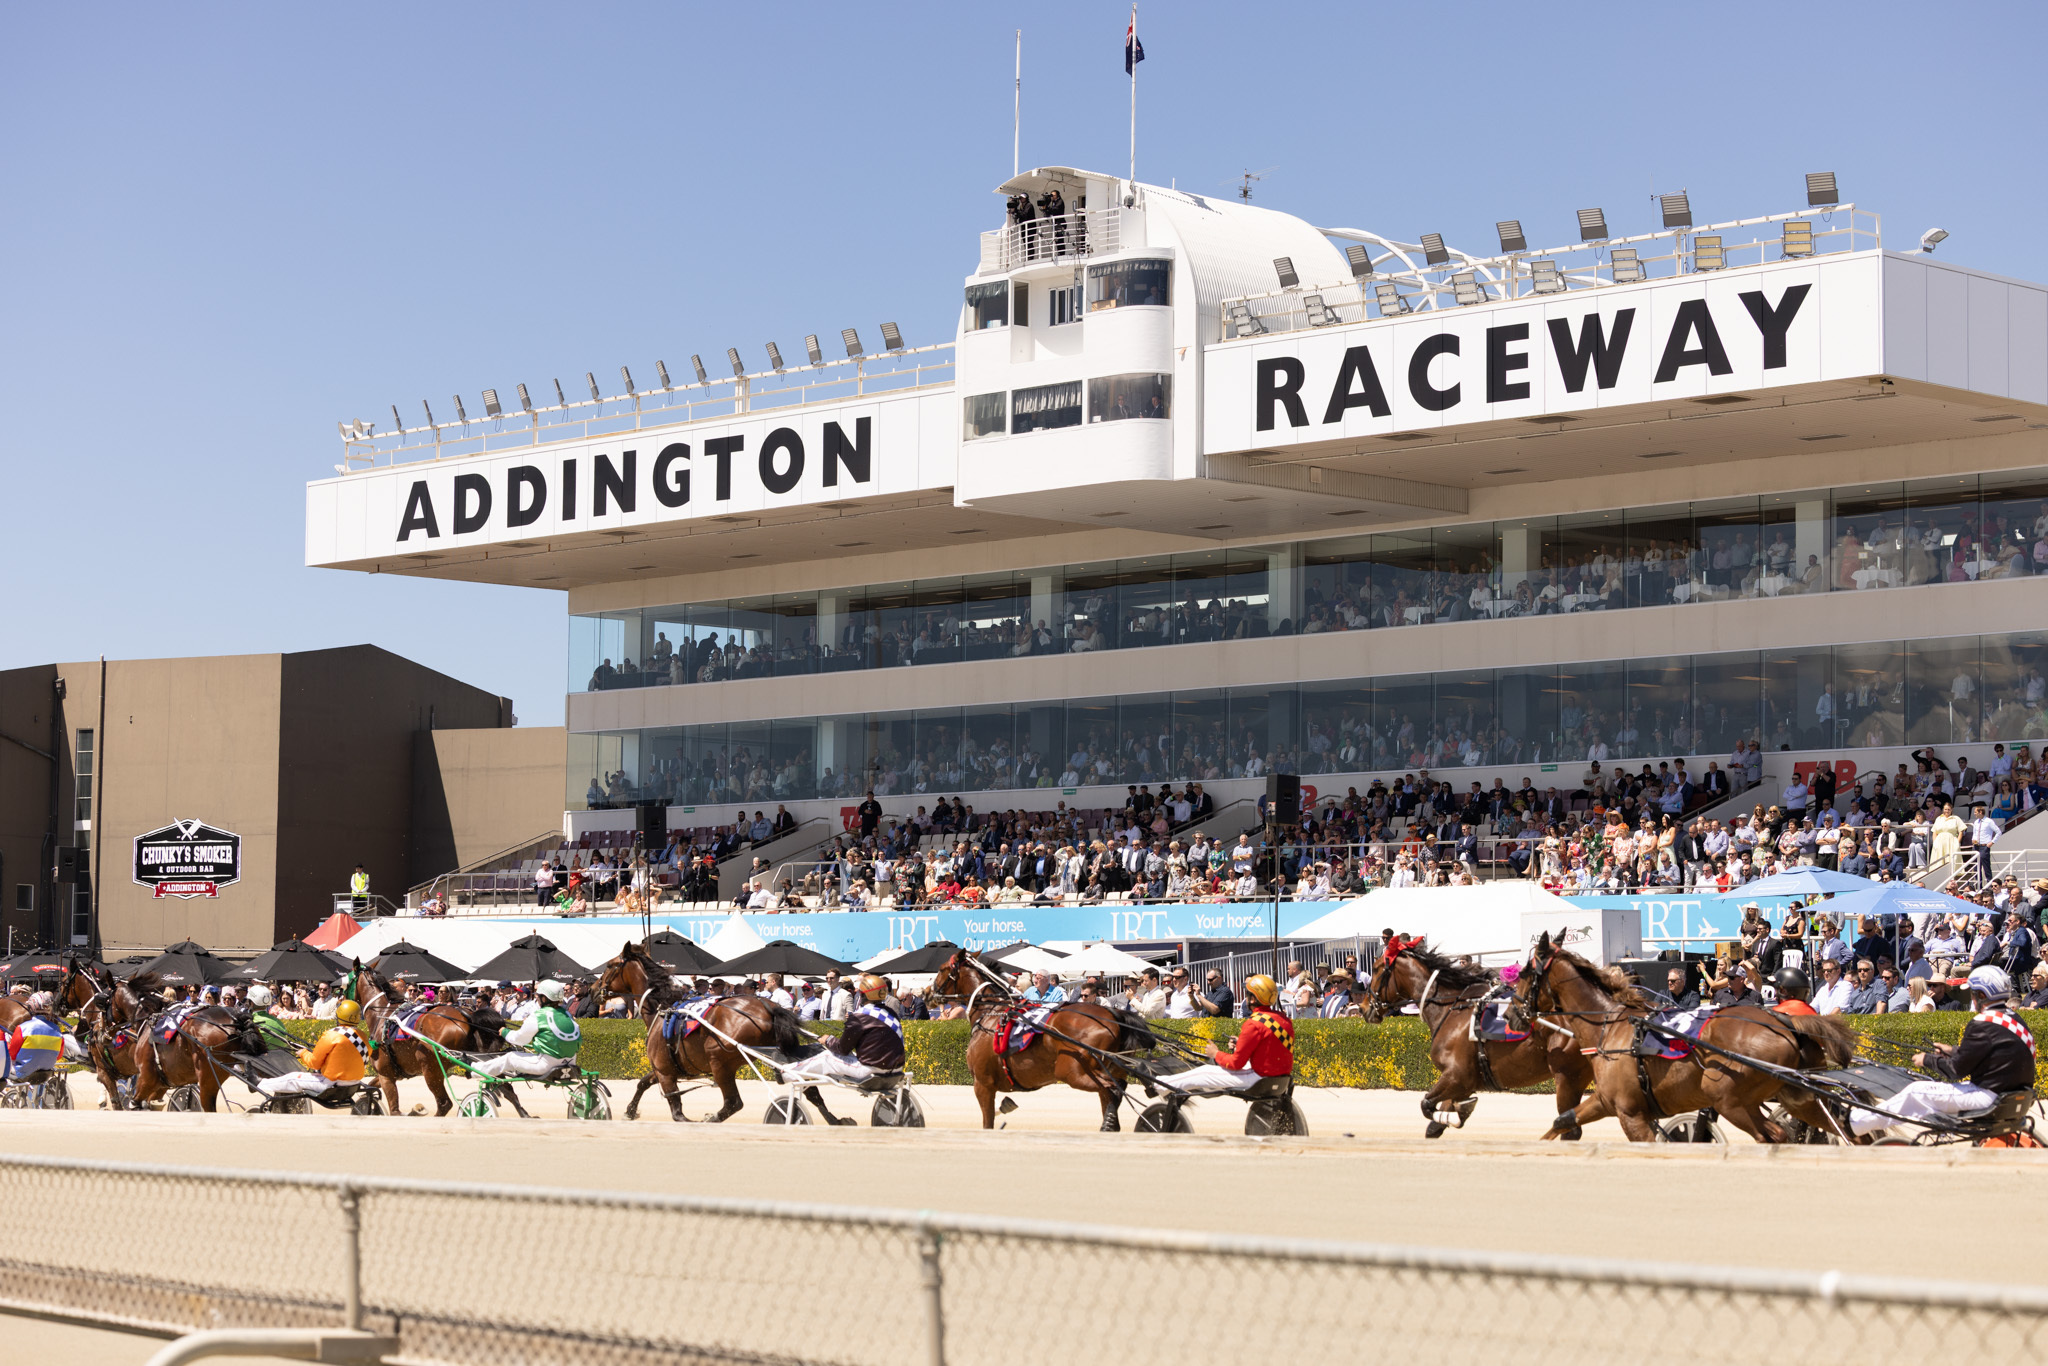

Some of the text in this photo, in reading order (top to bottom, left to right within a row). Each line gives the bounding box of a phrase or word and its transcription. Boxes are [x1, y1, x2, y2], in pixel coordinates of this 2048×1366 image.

[396, 283, 1812, 542] ADDINGTON RACEWAY
[142, 845, 233, 865] CHUNKY'S SMOKER
[166, 865, 197, 873] OUTDOOR
[199, 865, 214, 873] BAR
[166, 883, 206, 892] ADDINGTON
[963, 917, 1027, 933] Your horse.
[1195, 912, 1265, 929] Your horse.
[757, 922, 814, 937] Your horse.
[963, 937, 985, 951] Our
